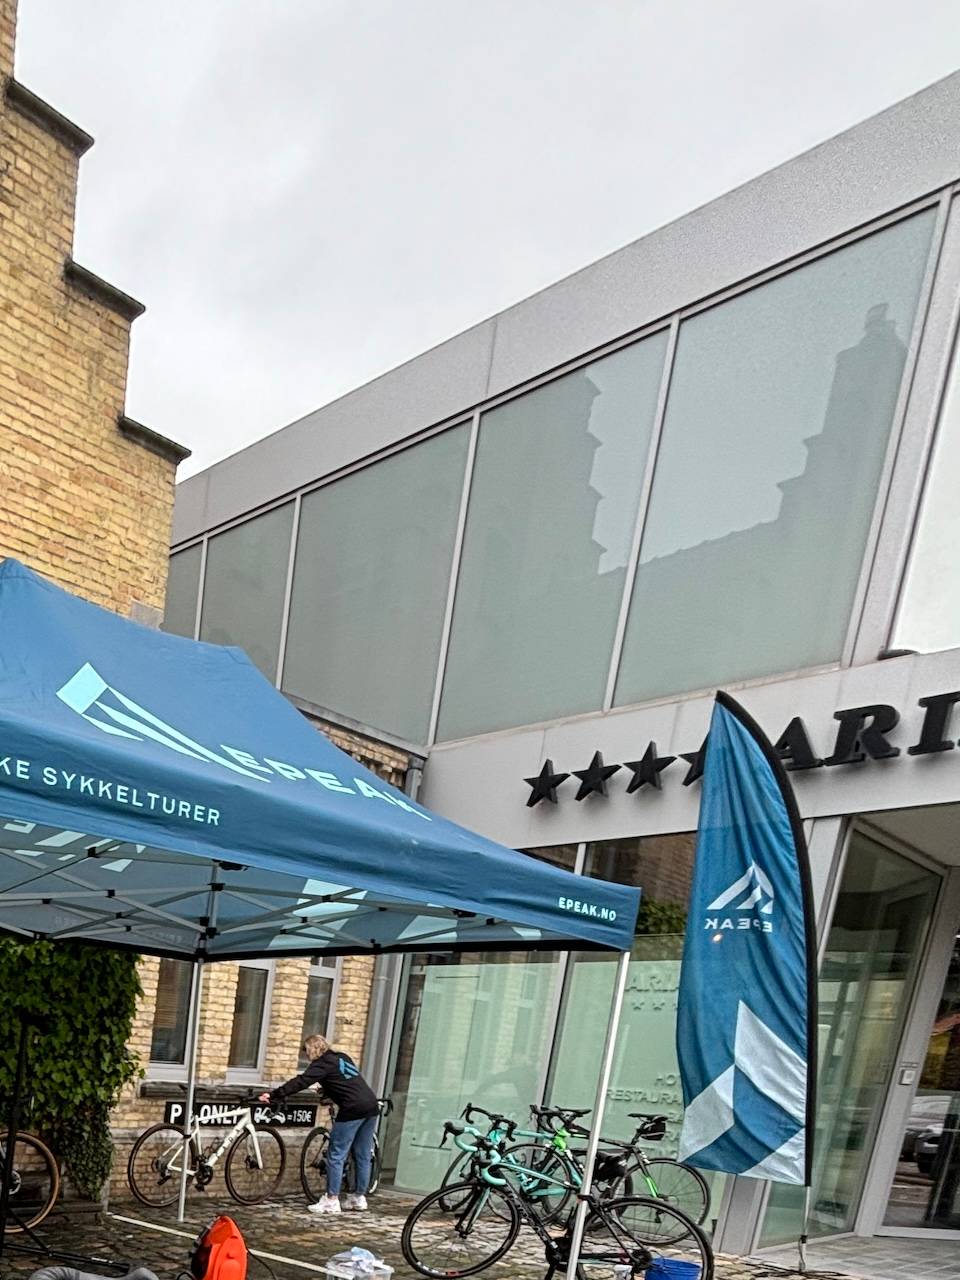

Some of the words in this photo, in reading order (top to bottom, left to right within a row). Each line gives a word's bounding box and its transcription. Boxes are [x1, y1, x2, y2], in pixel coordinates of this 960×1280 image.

[773, 690, 960, 772] ARI
[42, 766, 221, 827] SYKKELTURER
[219, 744, 433, 822] EPEAK
[558, 896, 618, 922] EPEAK.NO
[607, 1087, 681, 1104] RESTAURA
